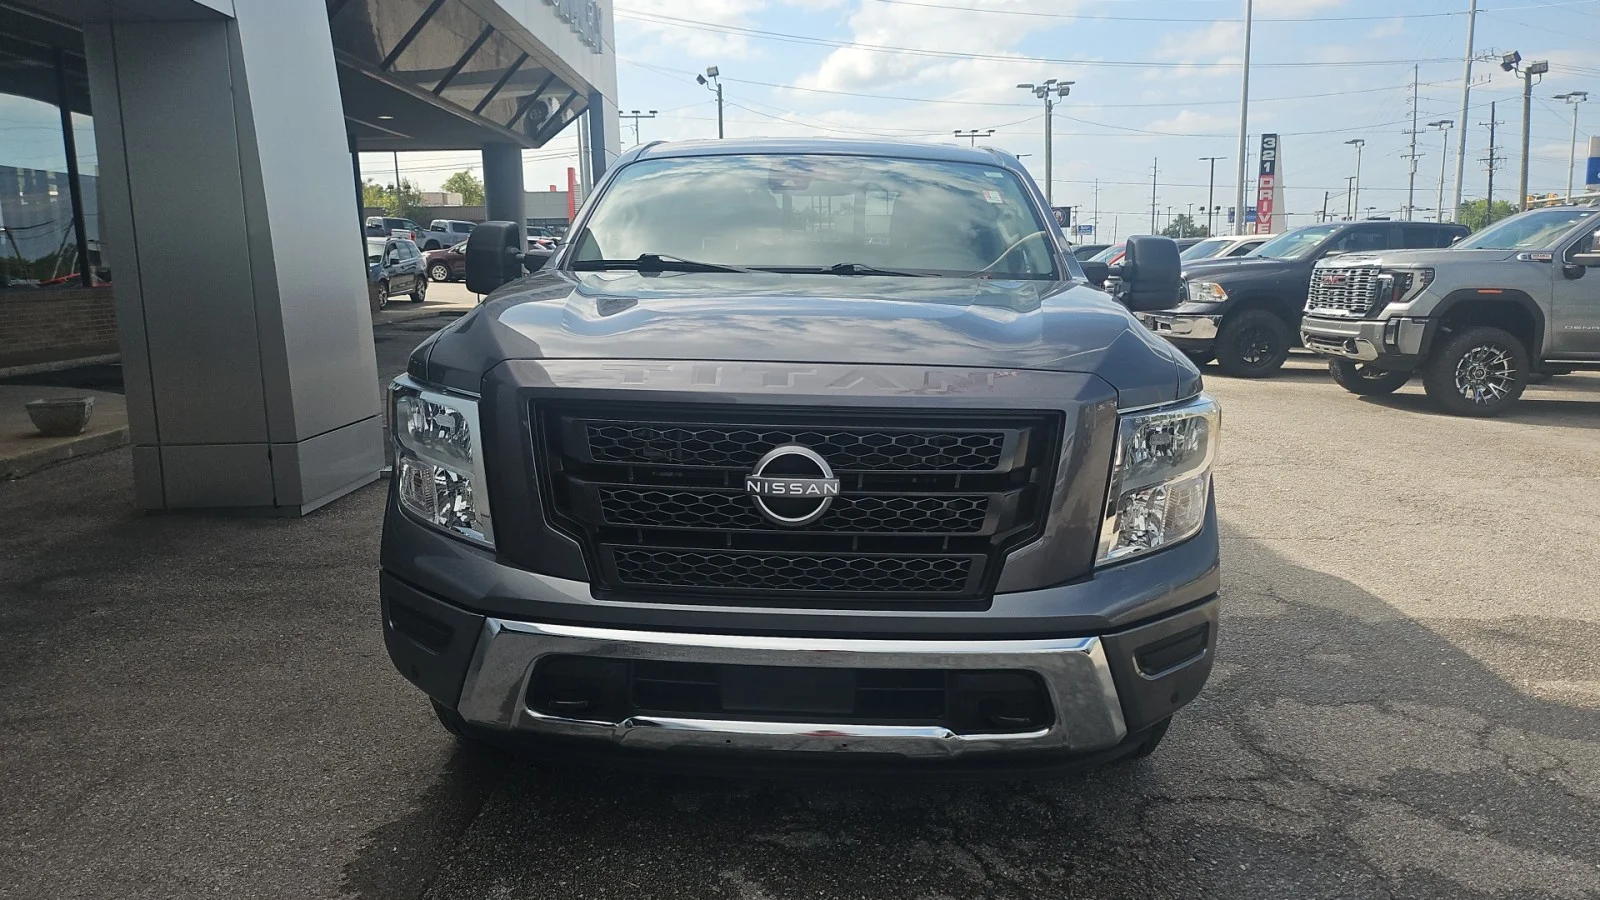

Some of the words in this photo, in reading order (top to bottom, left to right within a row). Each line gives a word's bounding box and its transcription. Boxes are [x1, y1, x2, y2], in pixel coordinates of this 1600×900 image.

[1262, 137, 1276, 173] 321
[1257, 177, 1274, 234] DRIVE
[600, 363, 996, 394] TITAN
[746, 480, 838, 495] NISSAN
